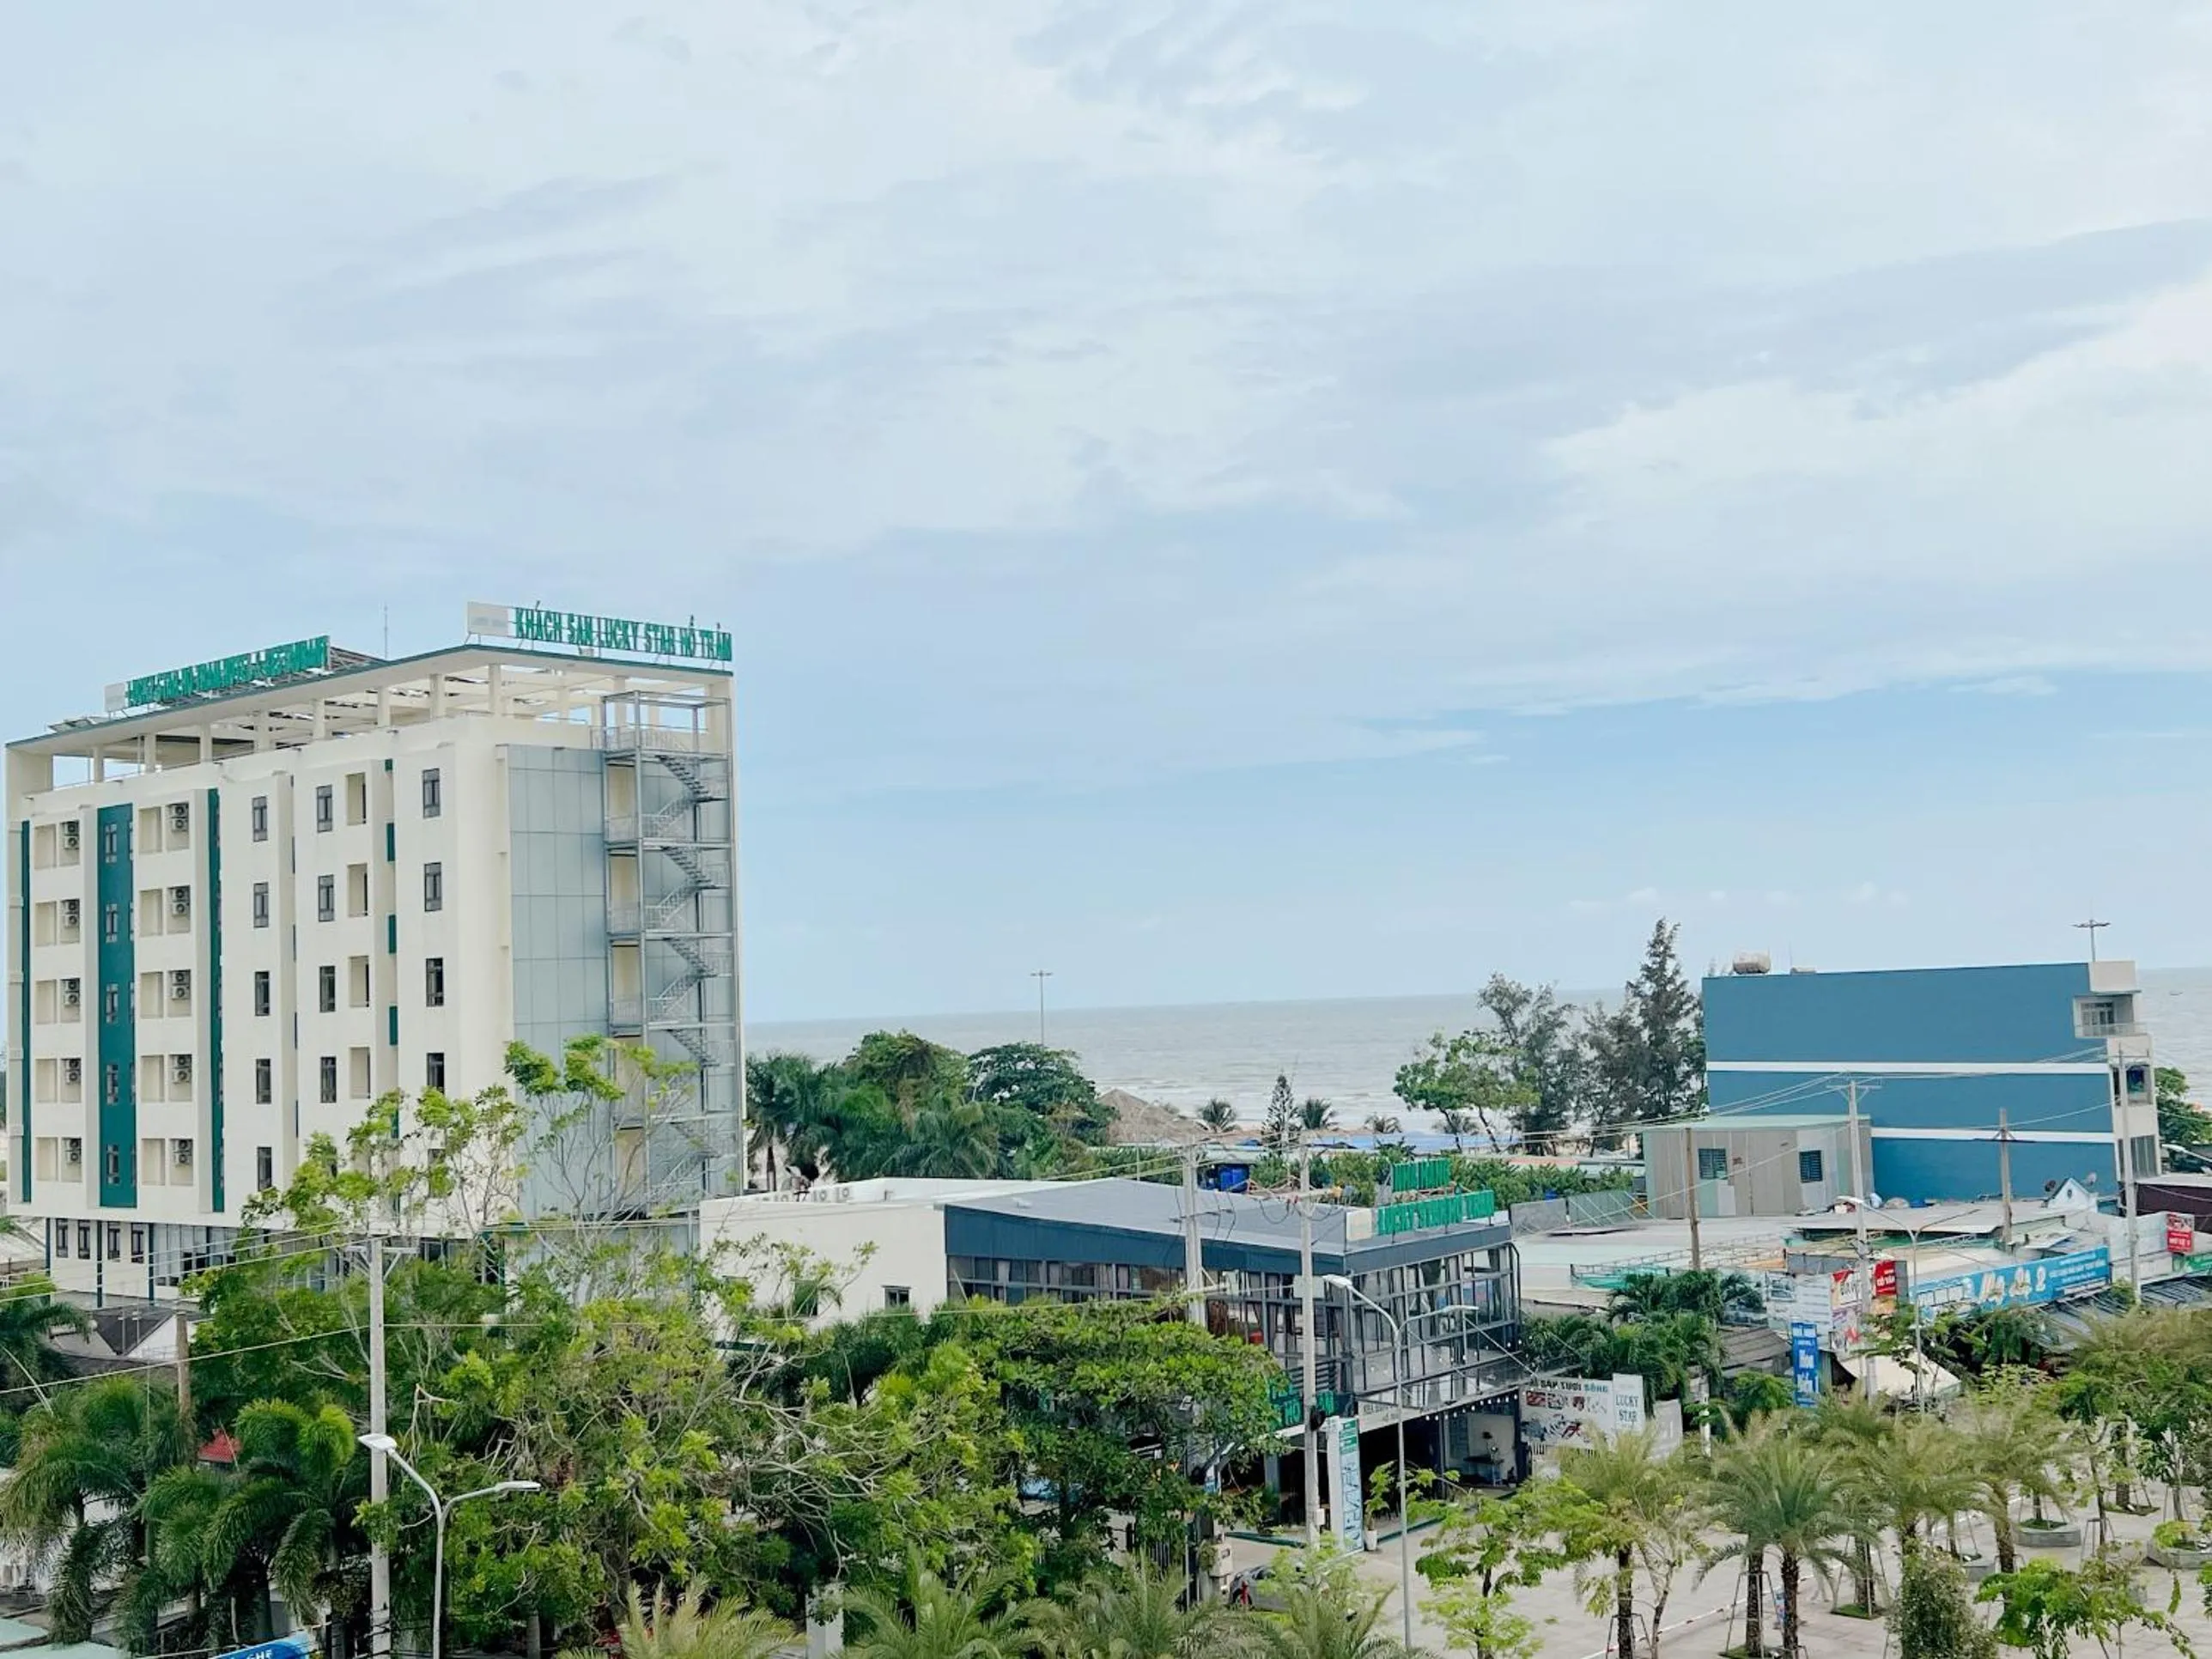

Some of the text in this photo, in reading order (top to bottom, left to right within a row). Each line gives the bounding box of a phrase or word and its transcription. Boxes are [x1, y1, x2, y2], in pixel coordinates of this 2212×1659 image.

[515, 600, 562, 642] KHÁCH
[597, 617, 639, 653] LUCKY
[644, 622, 675, 655] STAR
[1615, 1394, 1639, 1408] LUCKY
[1618, 1409, 1638, 1423] STAR
